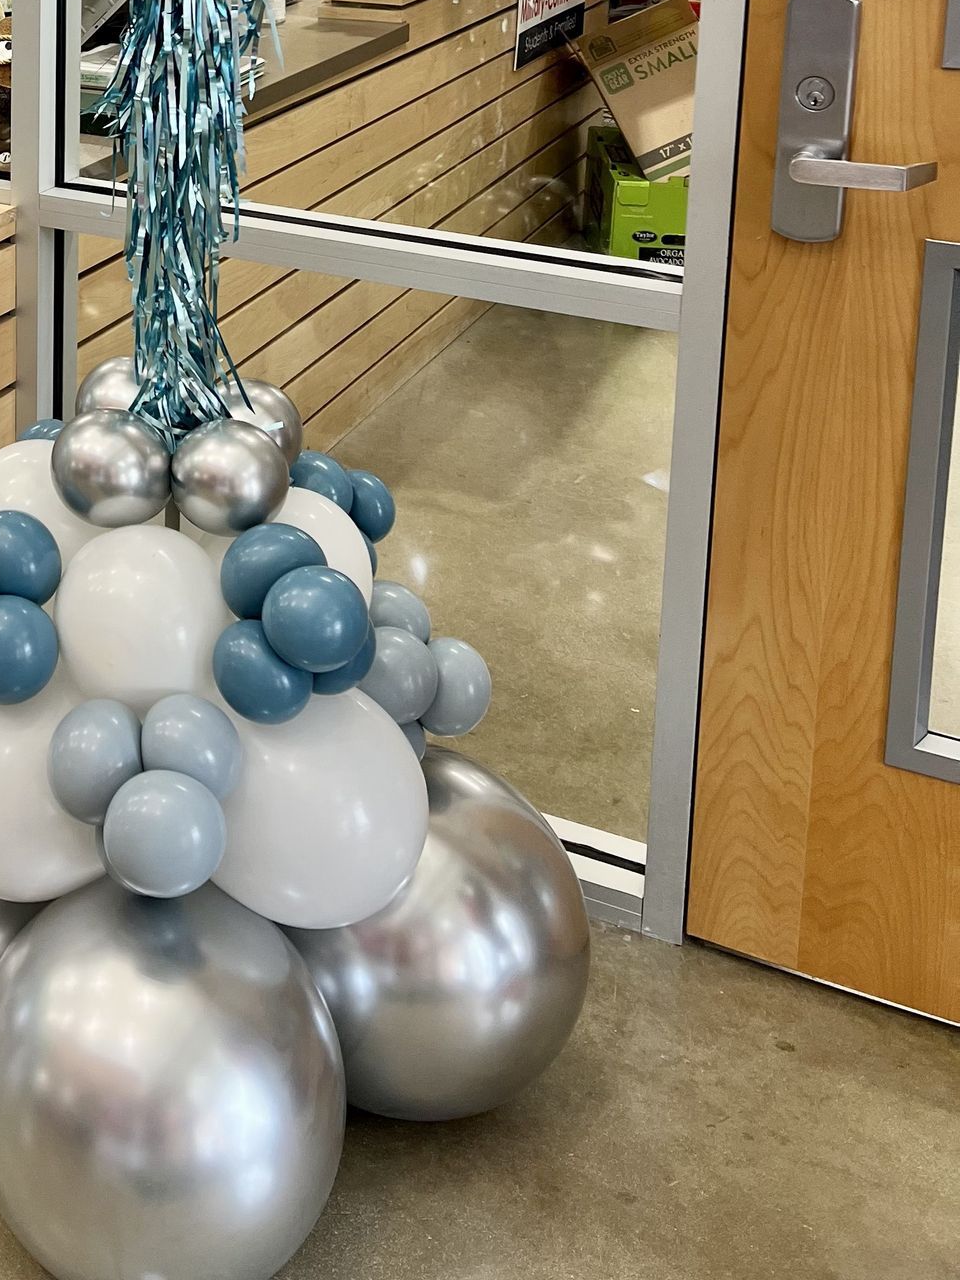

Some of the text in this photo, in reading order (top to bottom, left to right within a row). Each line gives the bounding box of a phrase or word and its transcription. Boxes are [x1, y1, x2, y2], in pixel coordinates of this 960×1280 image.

[524, 27, 548, 53] Students
[628, 30, 697, 66] EXTRA STRENGTH
[678, 142, 686, 151] x
